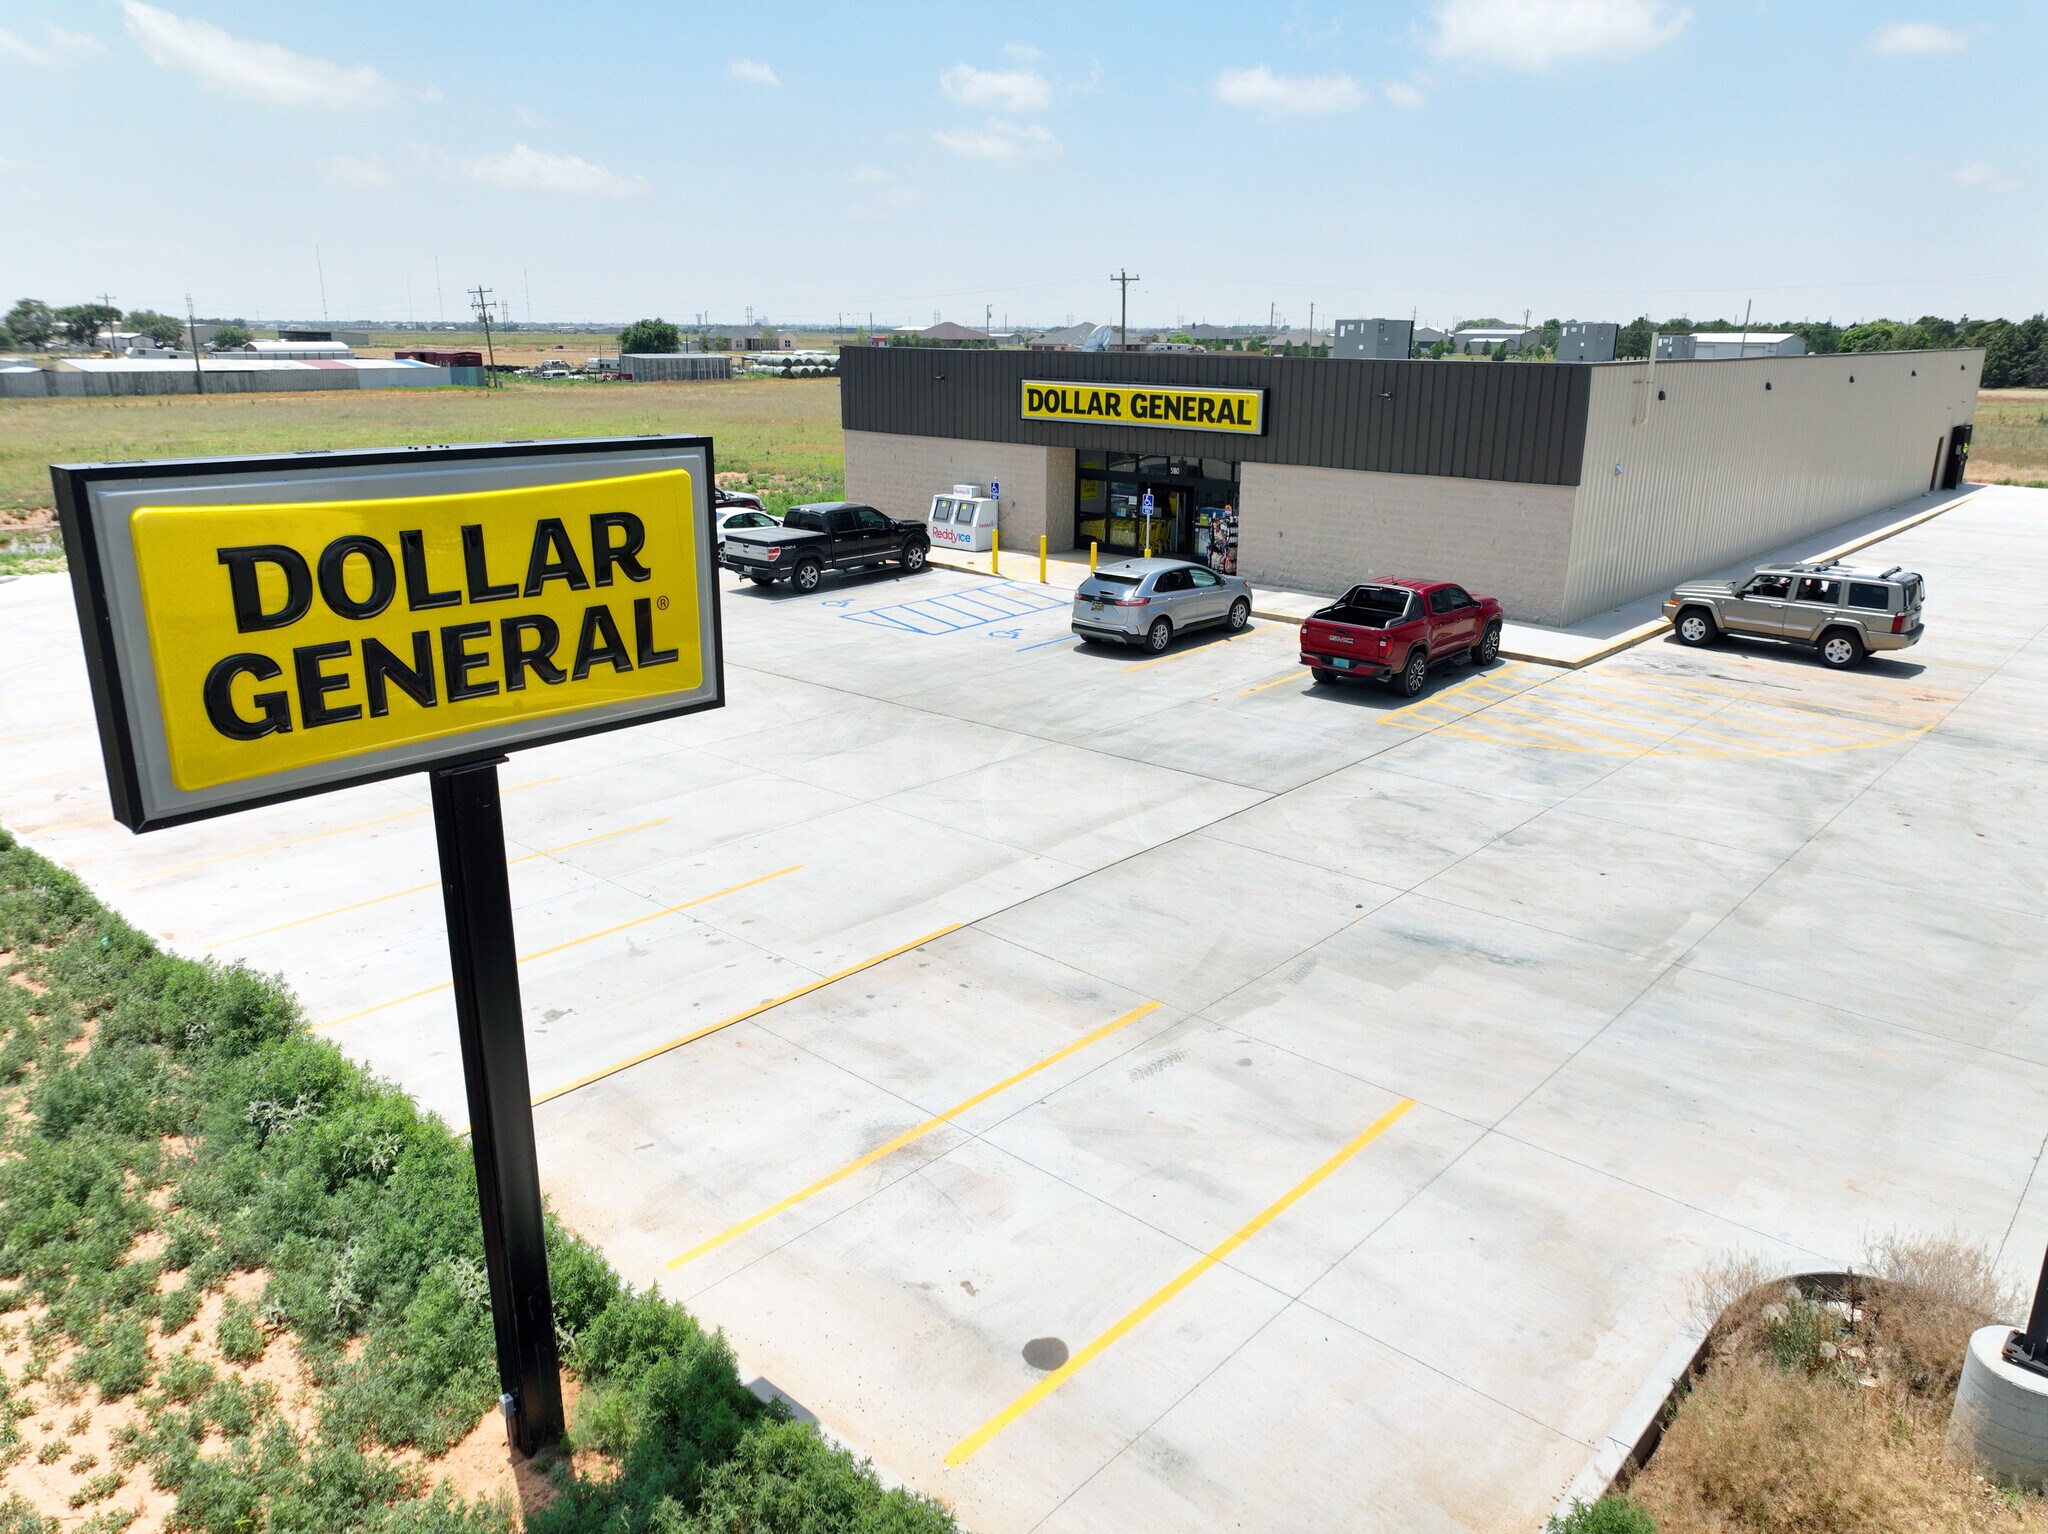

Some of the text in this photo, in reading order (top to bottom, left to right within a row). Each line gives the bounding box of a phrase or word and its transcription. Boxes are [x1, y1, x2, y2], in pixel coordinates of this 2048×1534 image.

[1027, 388, 1252, 426] DOLLAR GENERAL
[217, 511, 652, 634] DOLLAR
[1328, 635, 1354, 644] GMC
